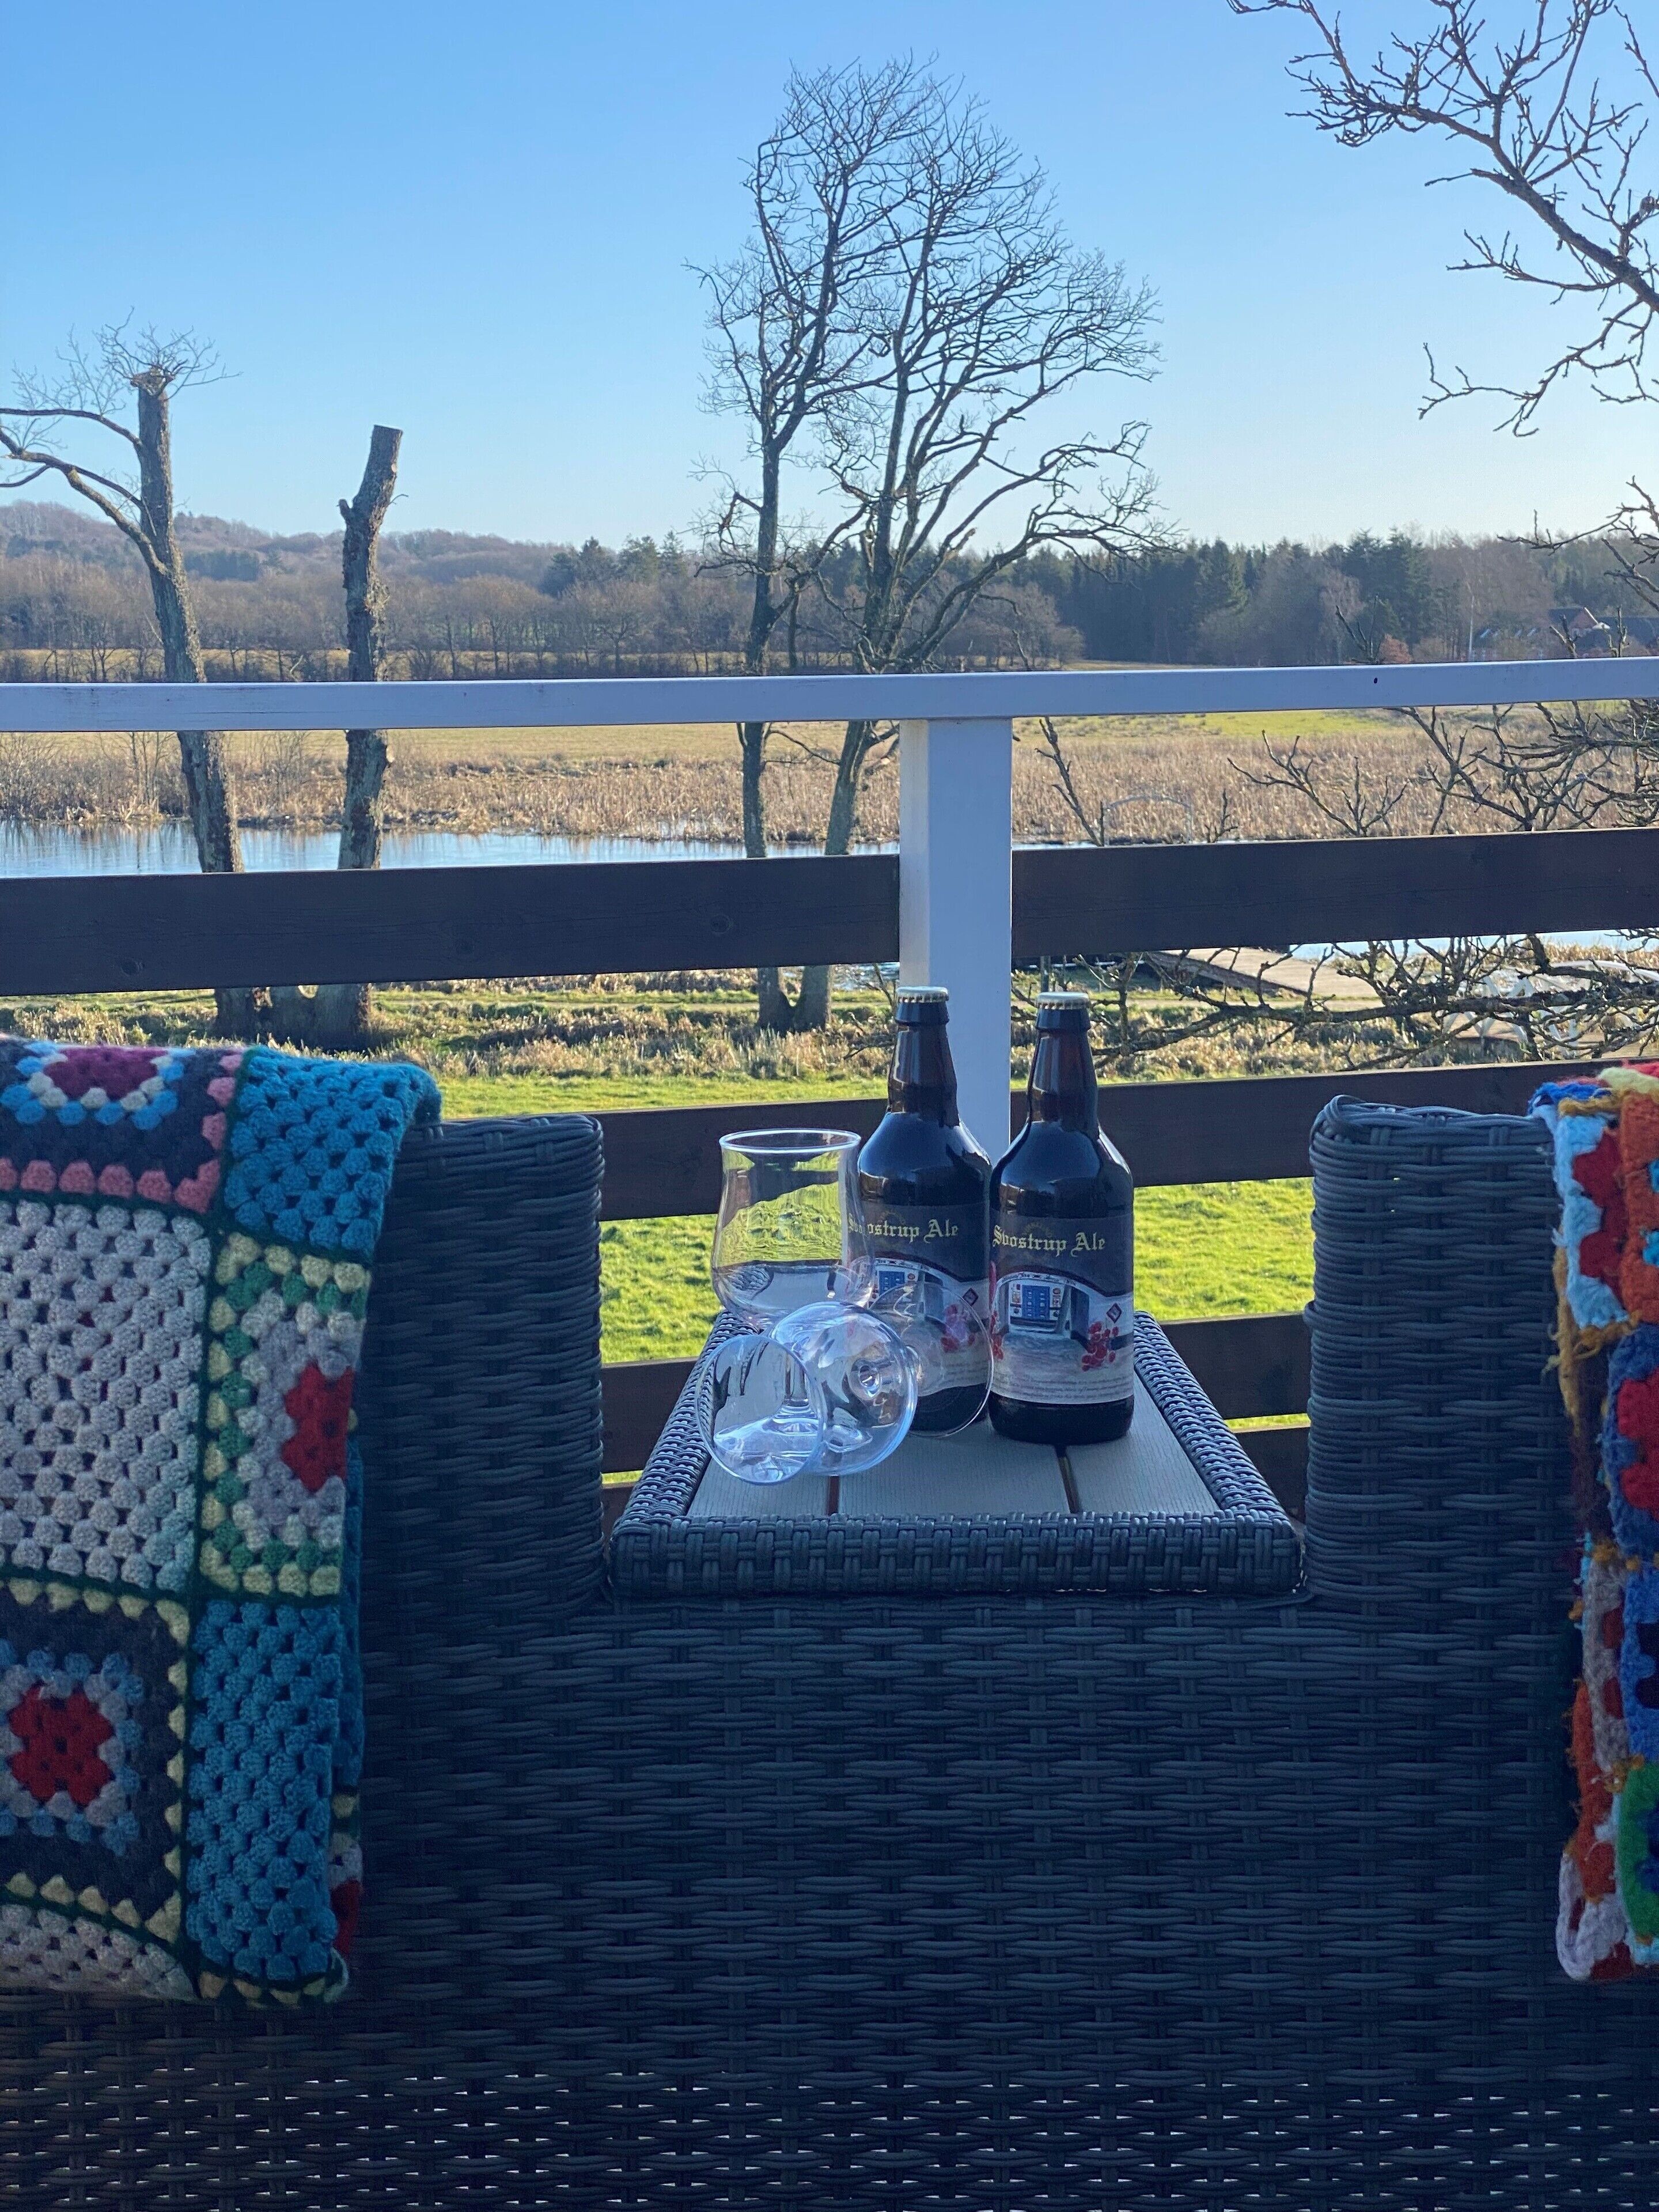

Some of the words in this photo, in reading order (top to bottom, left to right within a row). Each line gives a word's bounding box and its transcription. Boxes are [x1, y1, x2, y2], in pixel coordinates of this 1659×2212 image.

[923, 1219, 959, 1243] Ale
[993, 1225, 1066, 1257] Svostrup
[1071, 1232, 1105, 1257] Ale
